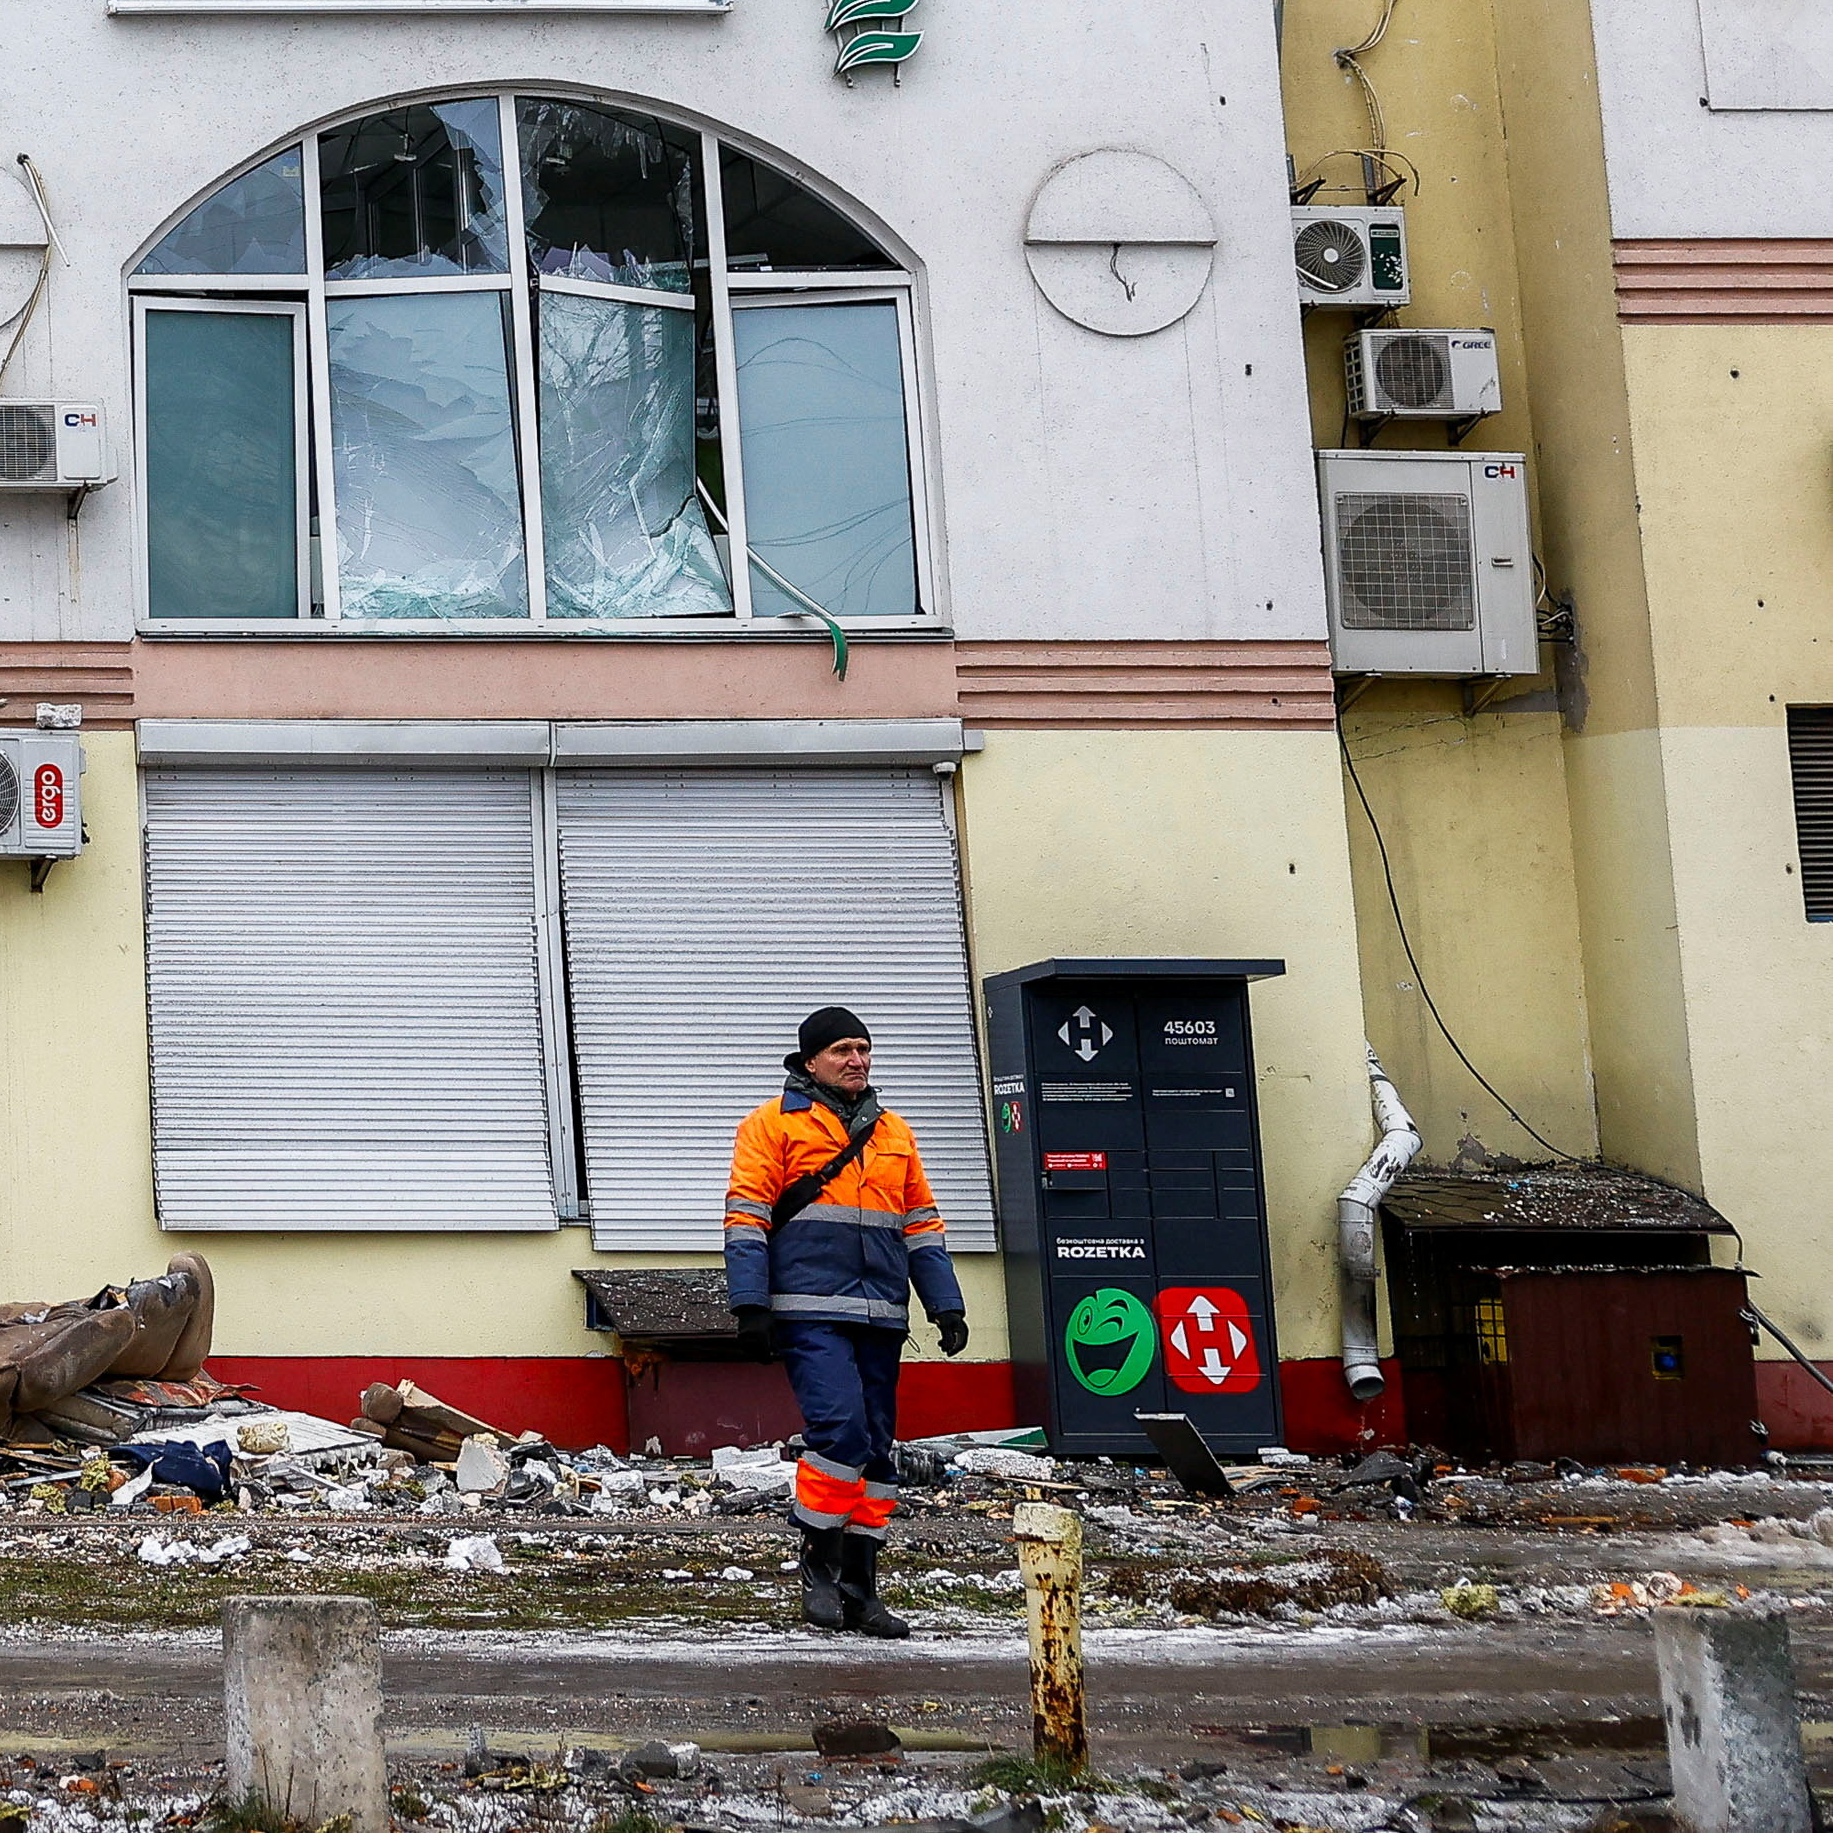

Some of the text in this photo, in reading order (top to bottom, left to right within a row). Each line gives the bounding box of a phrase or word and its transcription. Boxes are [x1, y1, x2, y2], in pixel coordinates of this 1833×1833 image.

[1462, 340, 1491, 349] GREE
[64, 413, 97, 427] CH
[1484, 465, 1516, 479] CH
[41, 770, 62, 822] ergo
[1163, 1020, 1216, 1035] 45603
[1164, 1037, 1219, 1045] поштомат
[993, 1081, 1025, 1096] ROZETKA
[1056, 1237, 1105, 1245] безкоштовна
[1105, 1238, 1138, 1246] доставка
[1057, 1245, 1146, 1259] ROZETKA
